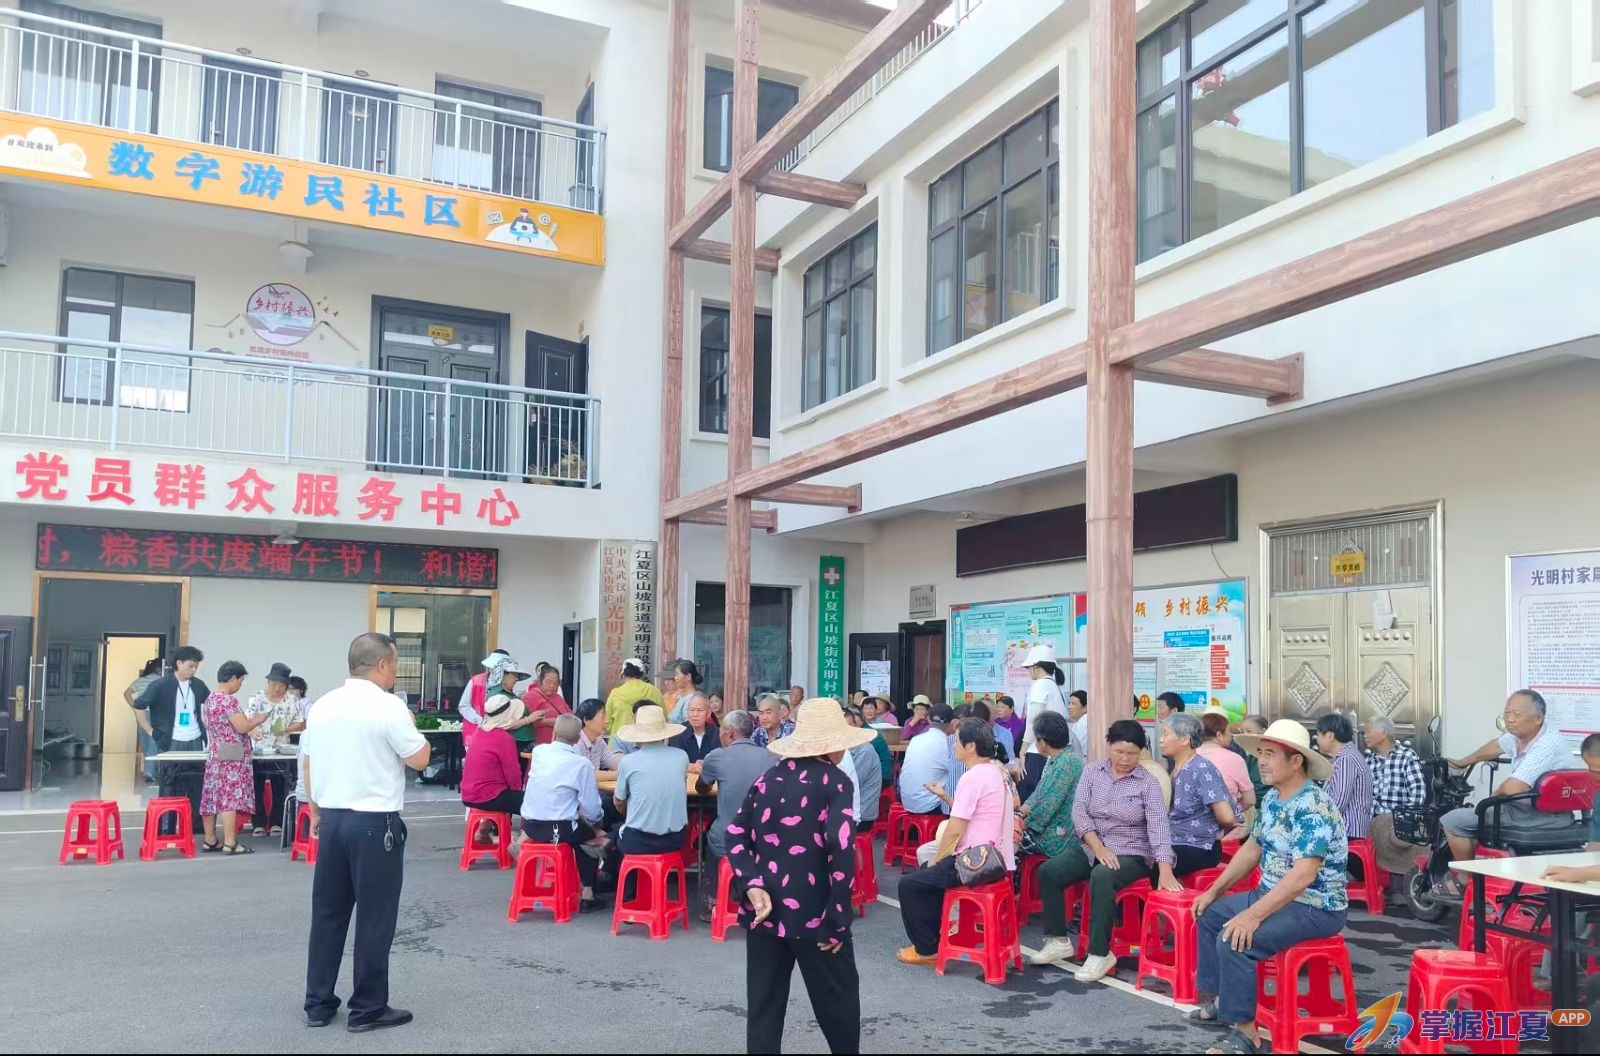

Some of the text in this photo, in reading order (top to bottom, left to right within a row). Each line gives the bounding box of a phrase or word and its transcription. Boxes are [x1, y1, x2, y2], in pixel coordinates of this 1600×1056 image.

[107, 140, 461, 228] 数字游民社区
[254, 297, 310, 316] 乡村振兴
[15, 451, 521, 527] 党员群众服务中心
[1163, 595, 1230, 618] 乡村振兴
